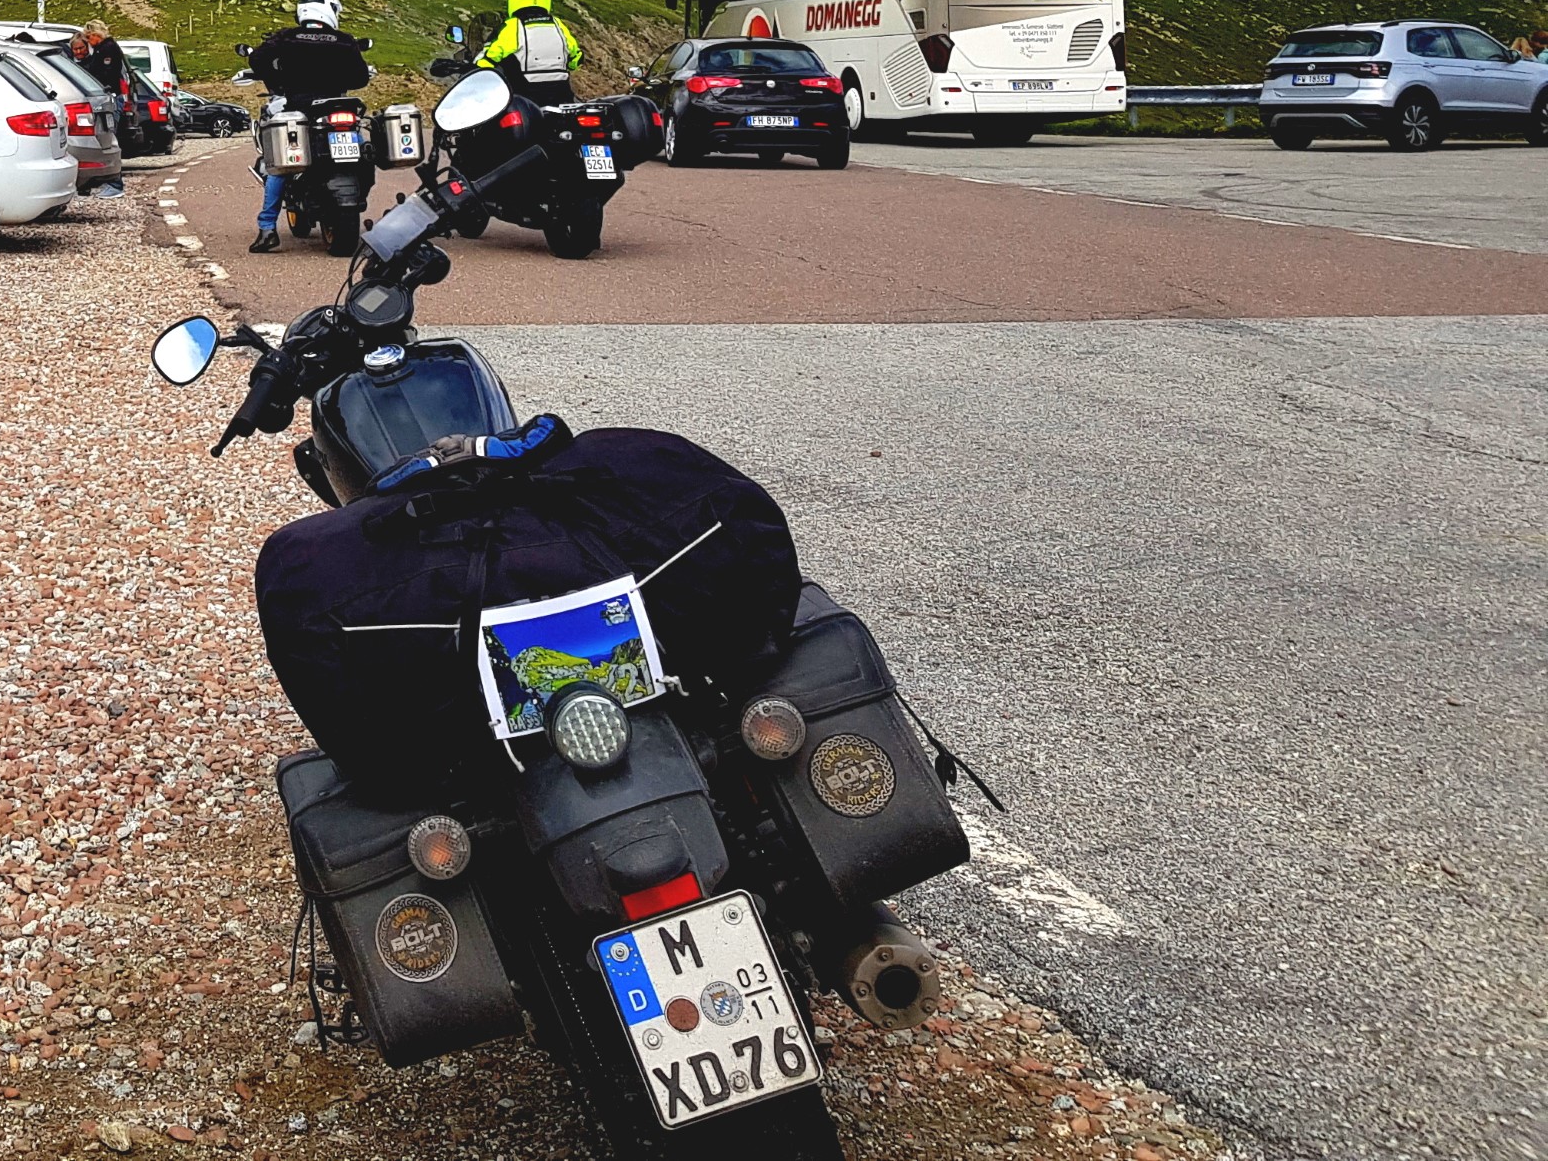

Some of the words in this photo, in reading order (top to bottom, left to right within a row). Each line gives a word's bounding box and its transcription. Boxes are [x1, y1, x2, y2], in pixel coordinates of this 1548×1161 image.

[752, 116, 764, 124] FH
[335, 133, 347, 143] EM
[332, 145, 359, 156] 78198
[590, 146, 600, 156] EC
[586, 159, 613, 170] 52514
[822, 745, 864, 770] GERMAN
[825, 759, 875, 790] BOLT
[847, 783, 881, 805] RIDERS
[390, 922, 442, 952] BOLT
[657, 920, 703, 975] M
[736, 963, 768, 988] 03
[628, 989, 648, 1012] D
[751, 995, 780, 1020] 11
[652, 1051, 731, 1119] XD
[732, 1027, 807, 1090] 76
